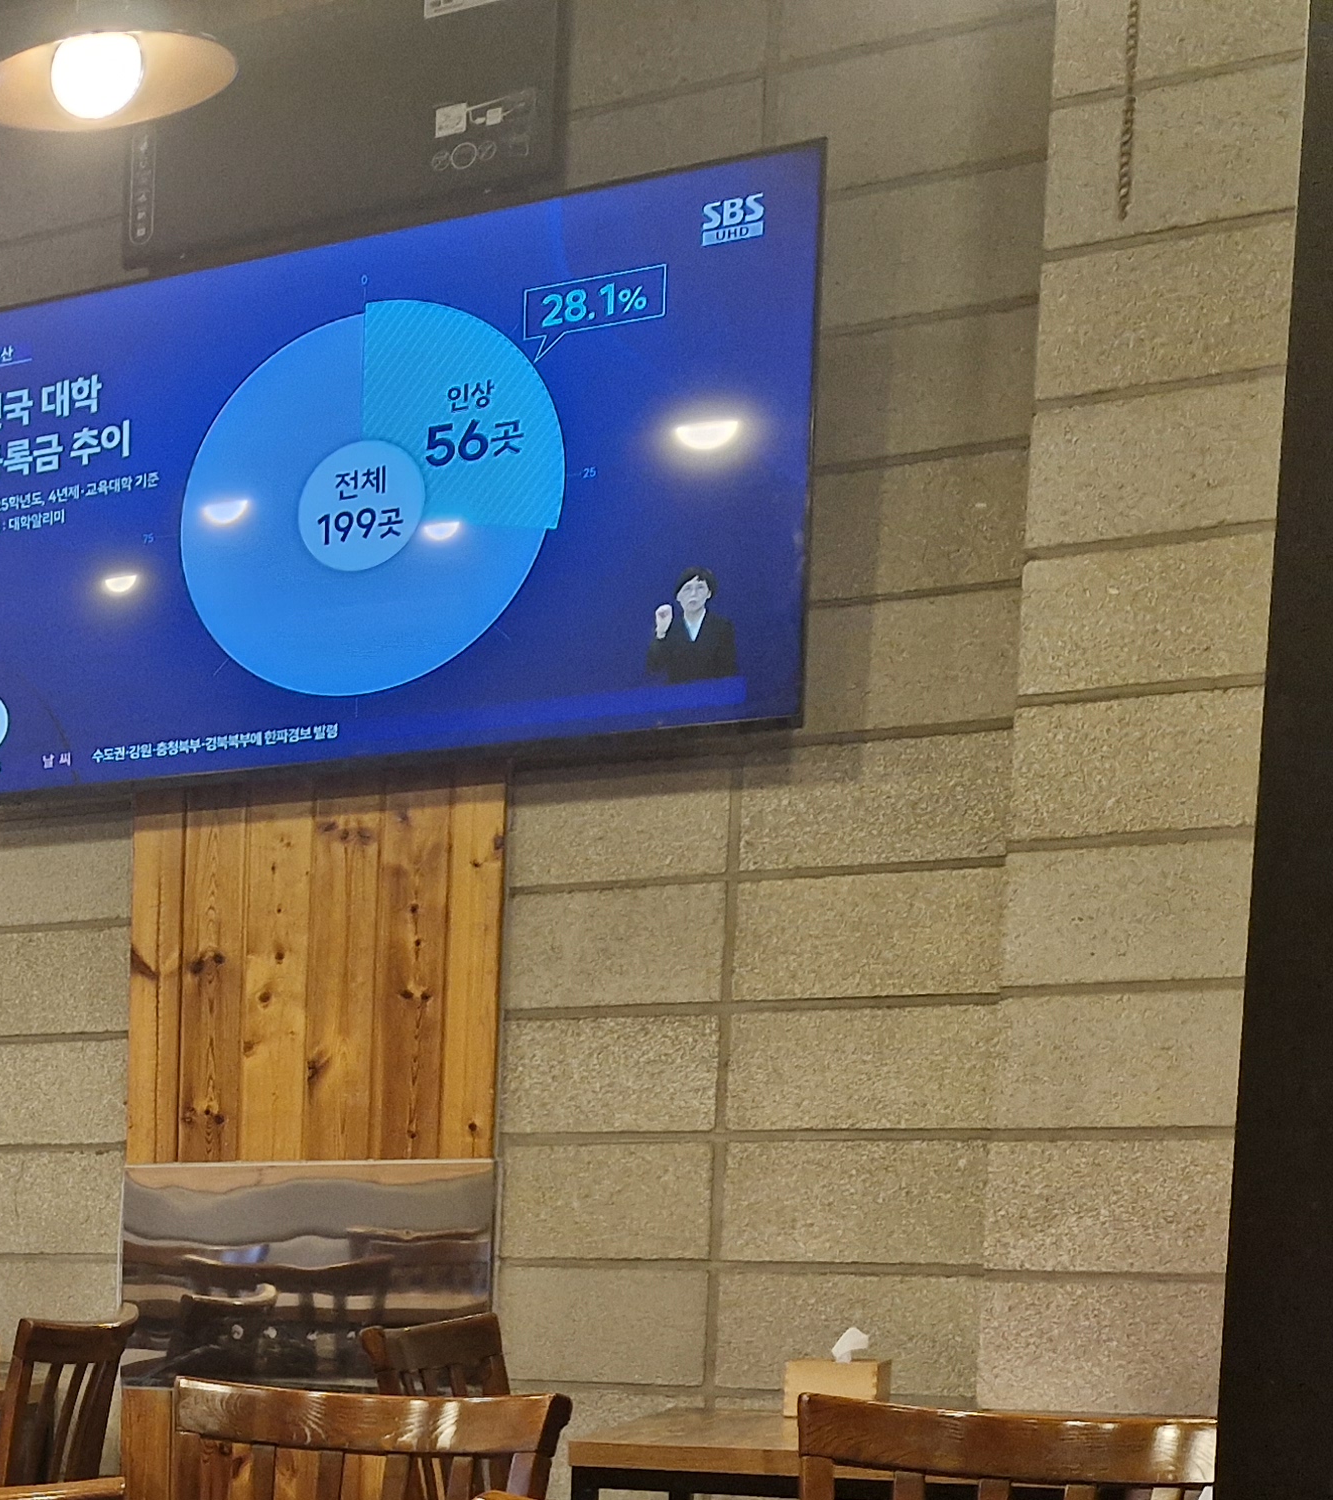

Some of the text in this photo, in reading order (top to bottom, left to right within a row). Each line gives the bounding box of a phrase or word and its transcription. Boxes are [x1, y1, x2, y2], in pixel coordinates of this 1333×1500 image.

[702, 192, 765, 230] SBS
[716, 226, 749, 241] UHD
[541, 282, 648, 328] 28.1%
[41, 373, 103, 418] 대학
[447, 378, 495, 413] 인상
[69, 418, 131, 465] 추이
[424, 418, 525, 467] 56곳
[134, 471, 160, 489] 기준
[334, 465, 388, 500] 전체
[8, 509, 66, 531] 대학알리미
[317, 507, 404, 546] 199곳
